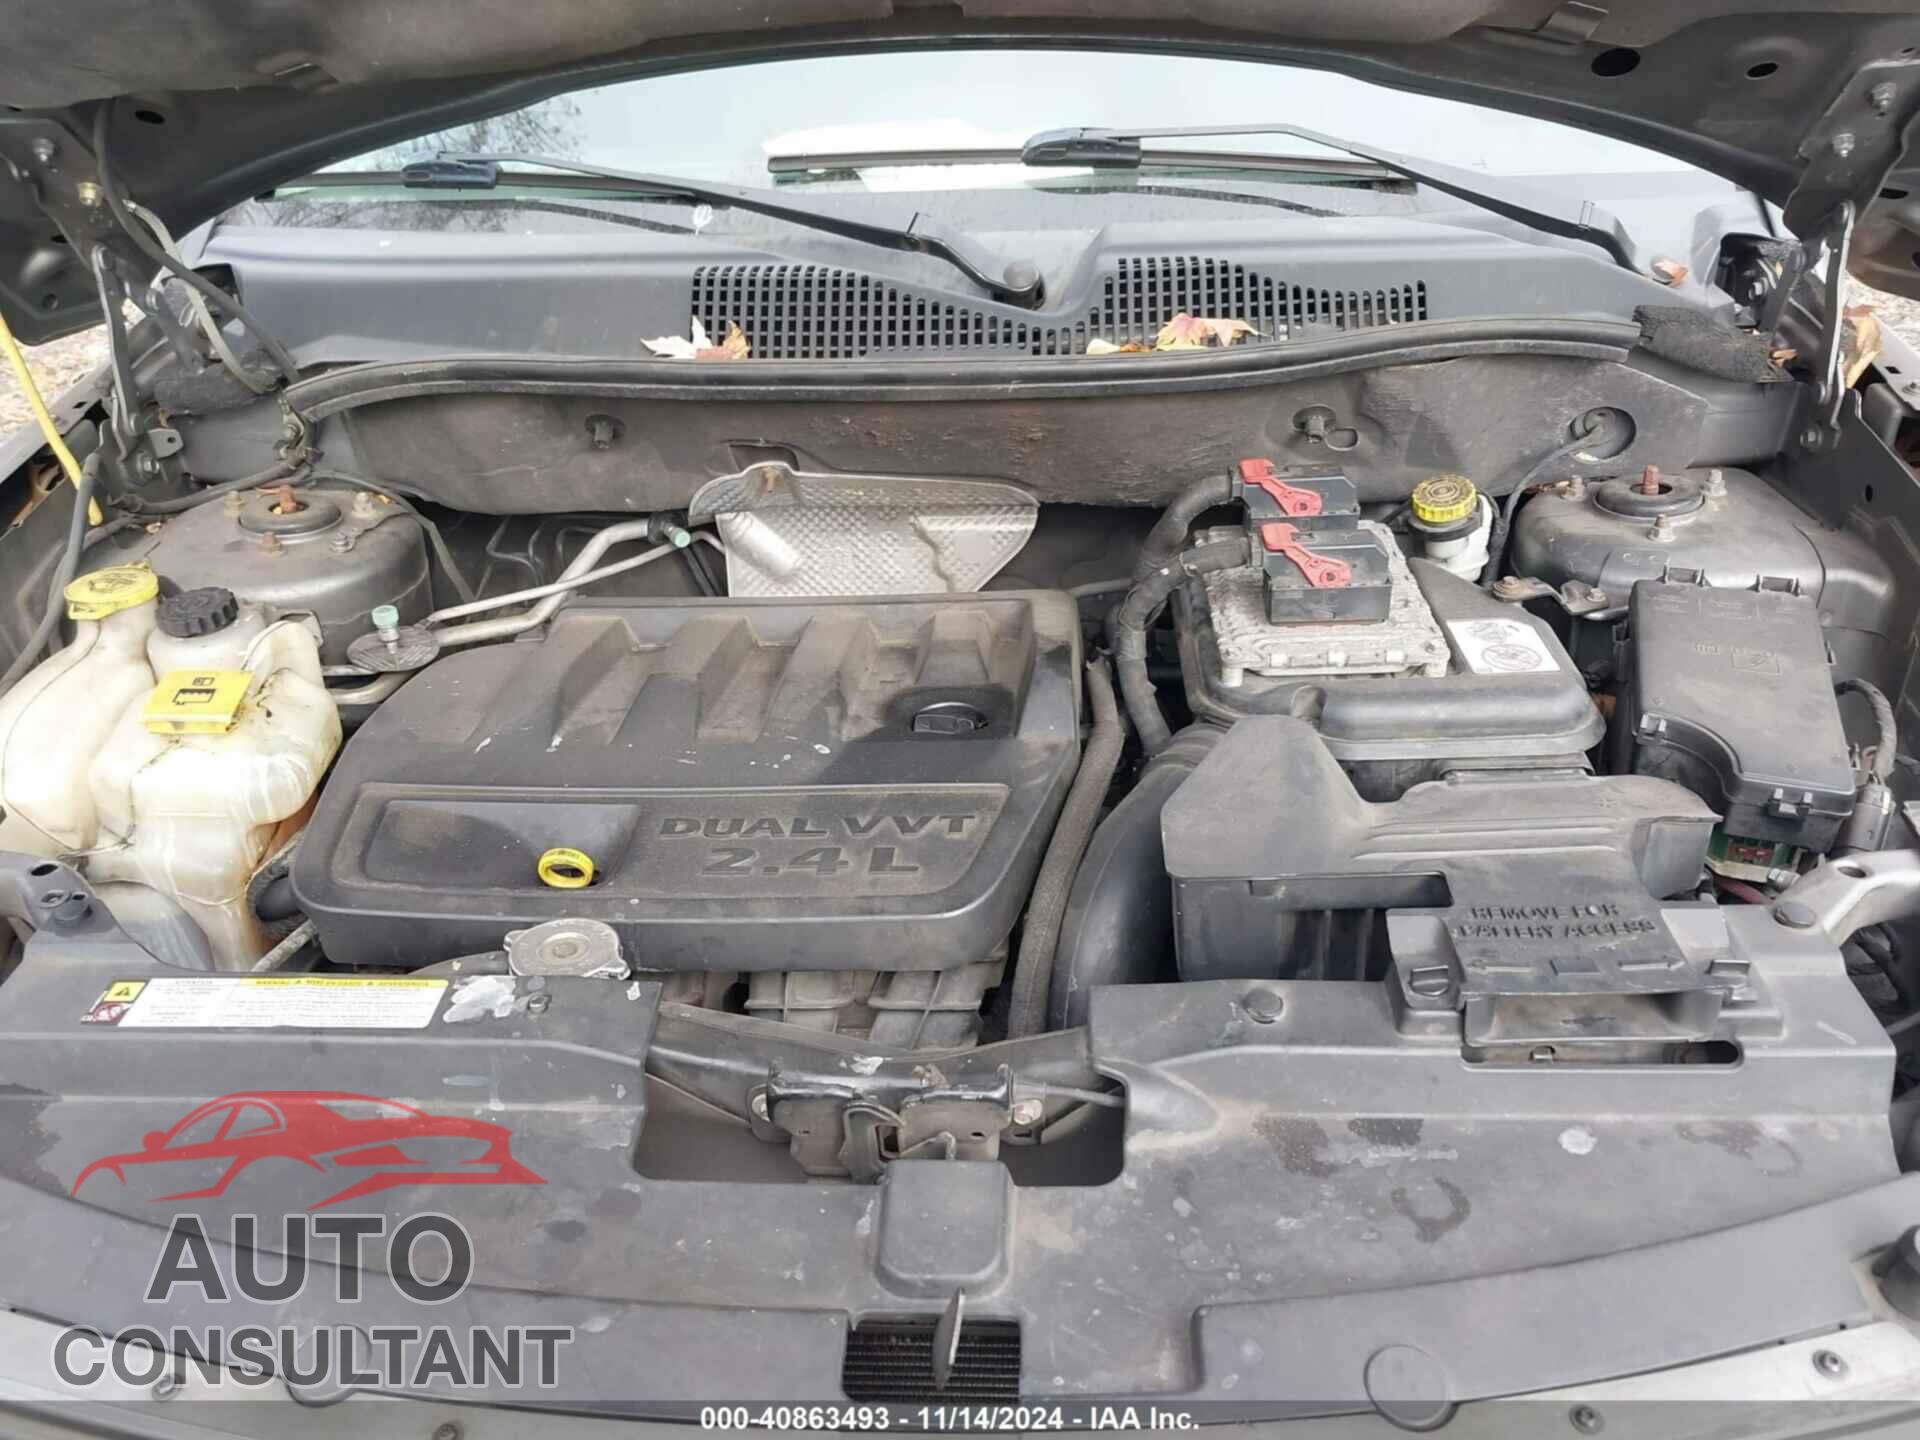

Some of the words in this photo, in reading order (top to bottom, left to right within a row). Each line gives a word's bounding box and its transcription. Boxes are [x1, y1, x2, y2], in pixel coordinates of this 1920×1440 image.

[657, 816, 829, 840] DUAL
[841, 814, 977, 839] VVT
[700, 846, 922, 877] 2.4L
[1469, 904, 1565, 921] REMOVE
[1570, 902, 1620, 918] FOR
[1457, 923, 1554, 939] BATTERY
[1563, 919, 1657, 938] ACCESS
